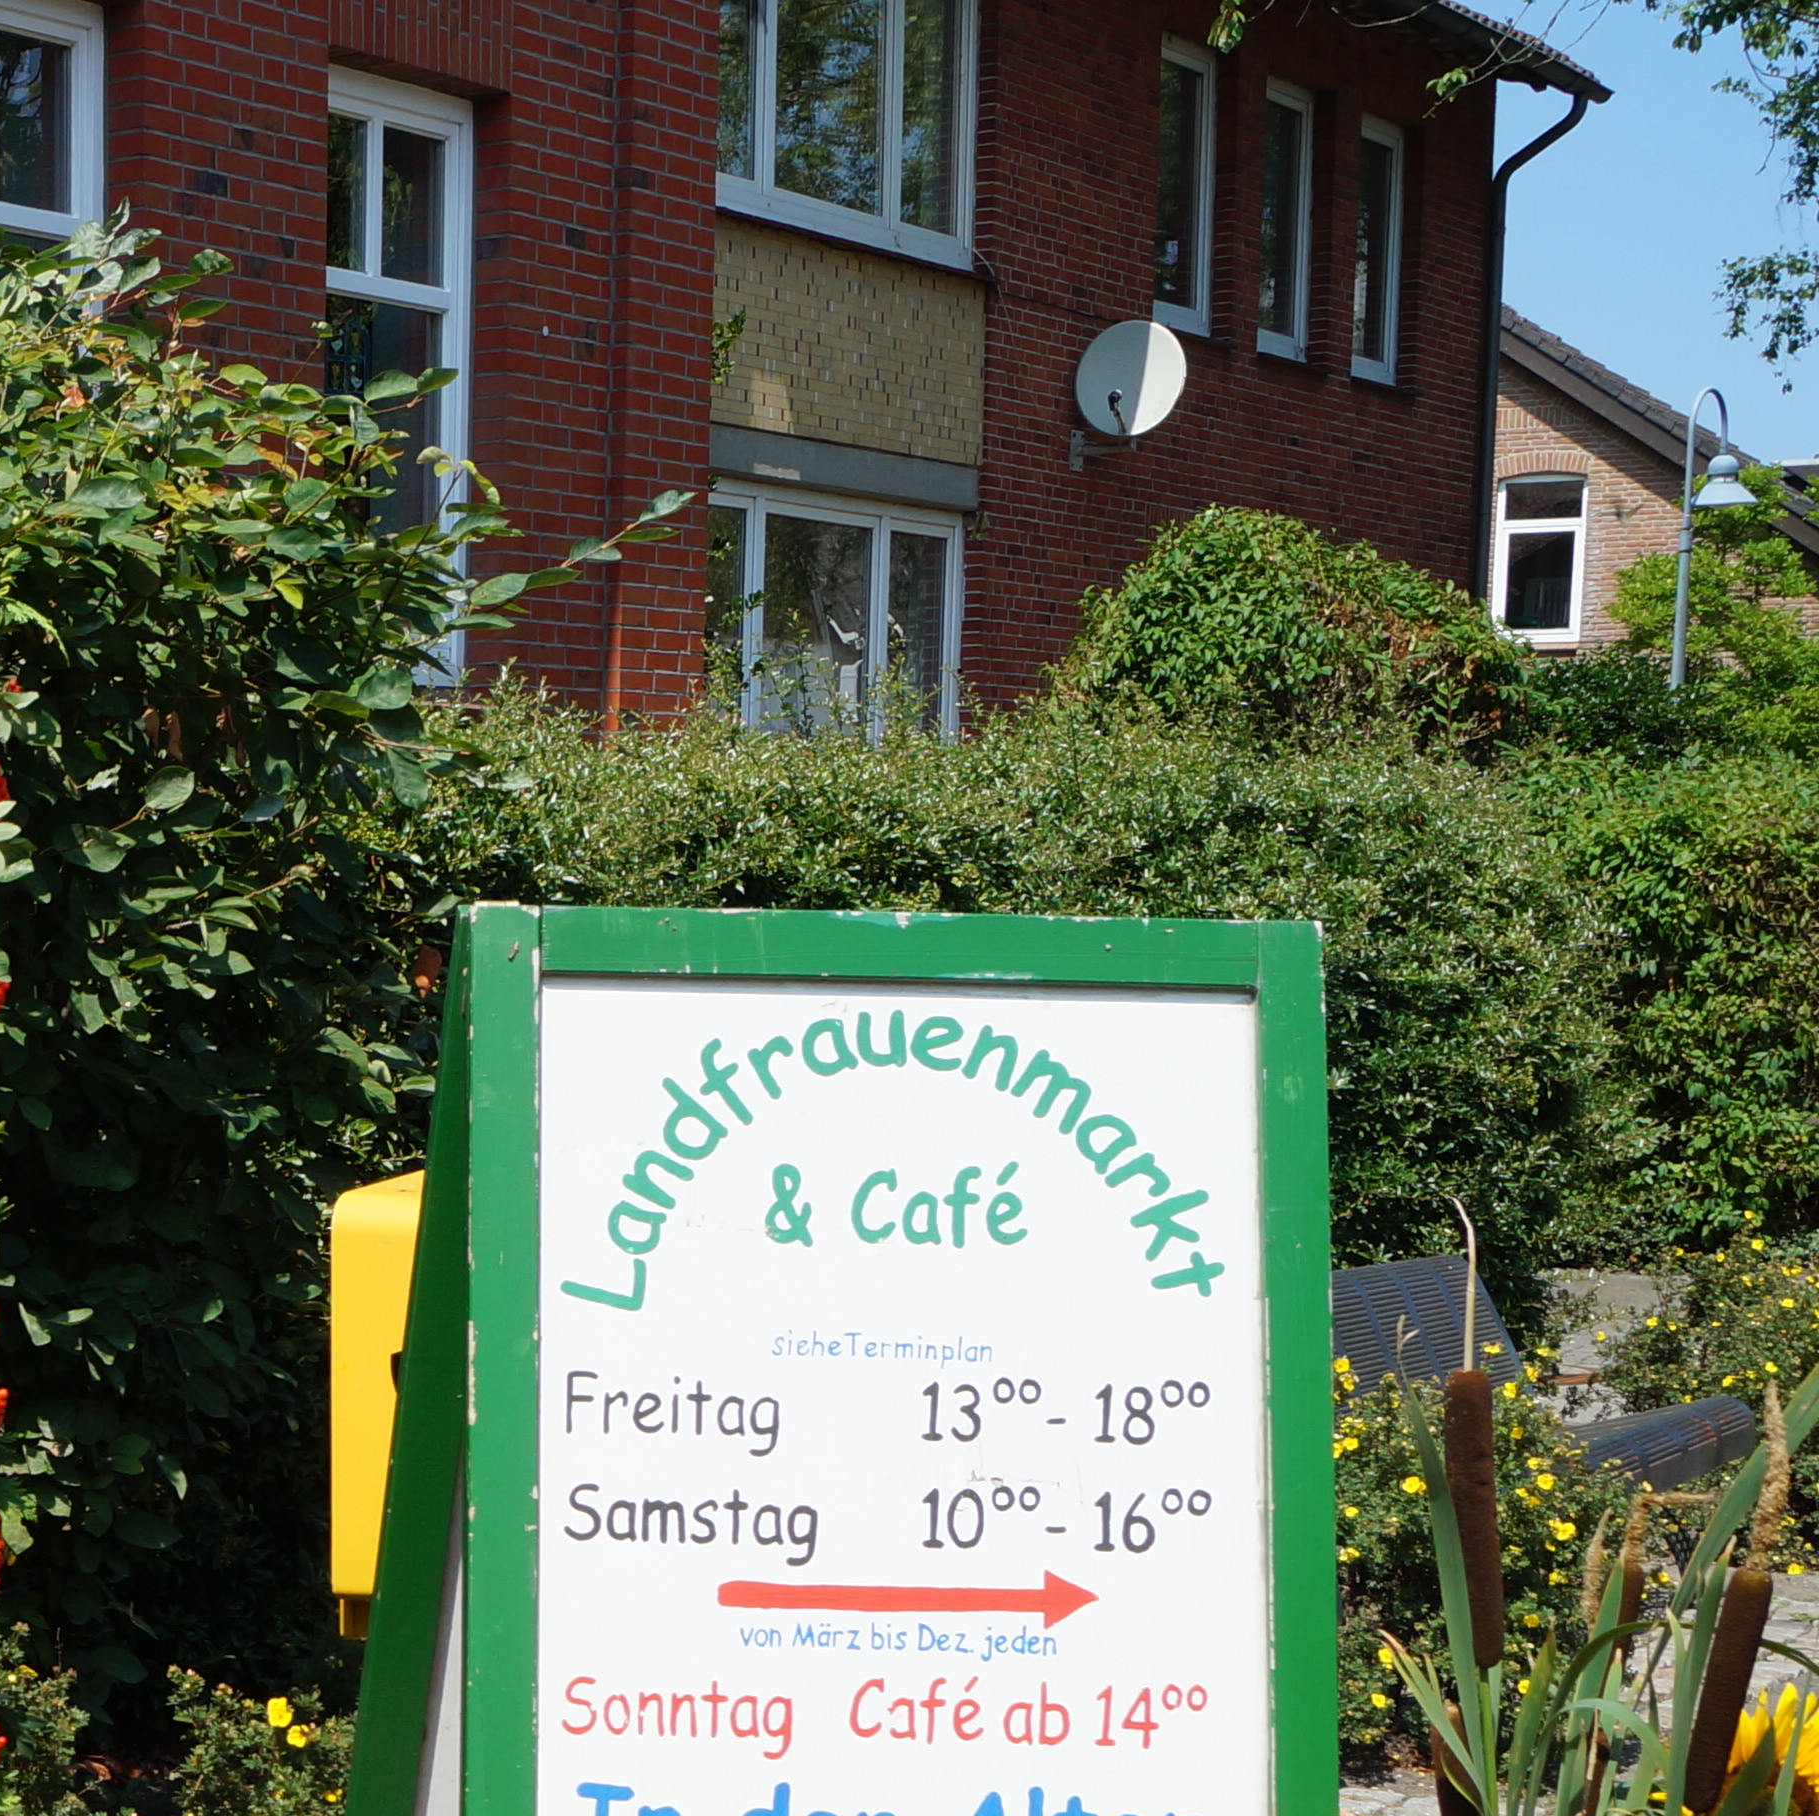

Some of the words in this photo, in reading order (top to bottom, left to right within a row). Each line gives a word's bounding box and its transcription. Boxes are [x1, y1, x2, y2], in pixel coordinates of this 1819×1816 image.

[559, 1008, 1226, 1312] Landfrauenmarkt
[763, 1162, 815, 1249] &
[850, 1160, 1029, 1250] Café
[564, 1369, 781, 1459] Freitag
[562, 1482, 819, 1568] Samstag
[738, 1626, 783, 1649] von
[791, 1622, 862, 1652] März
[870, 1621, 909, 1652] bis
[915, 1620, 976, 1656] Dez.
[977, 1621, 1059, 1659] jeden
[560, 1675, 794, 1762] Sonntag
[848, 1674, 985, 1746] Café
[1001, 1680, 1072, 1747] ab
